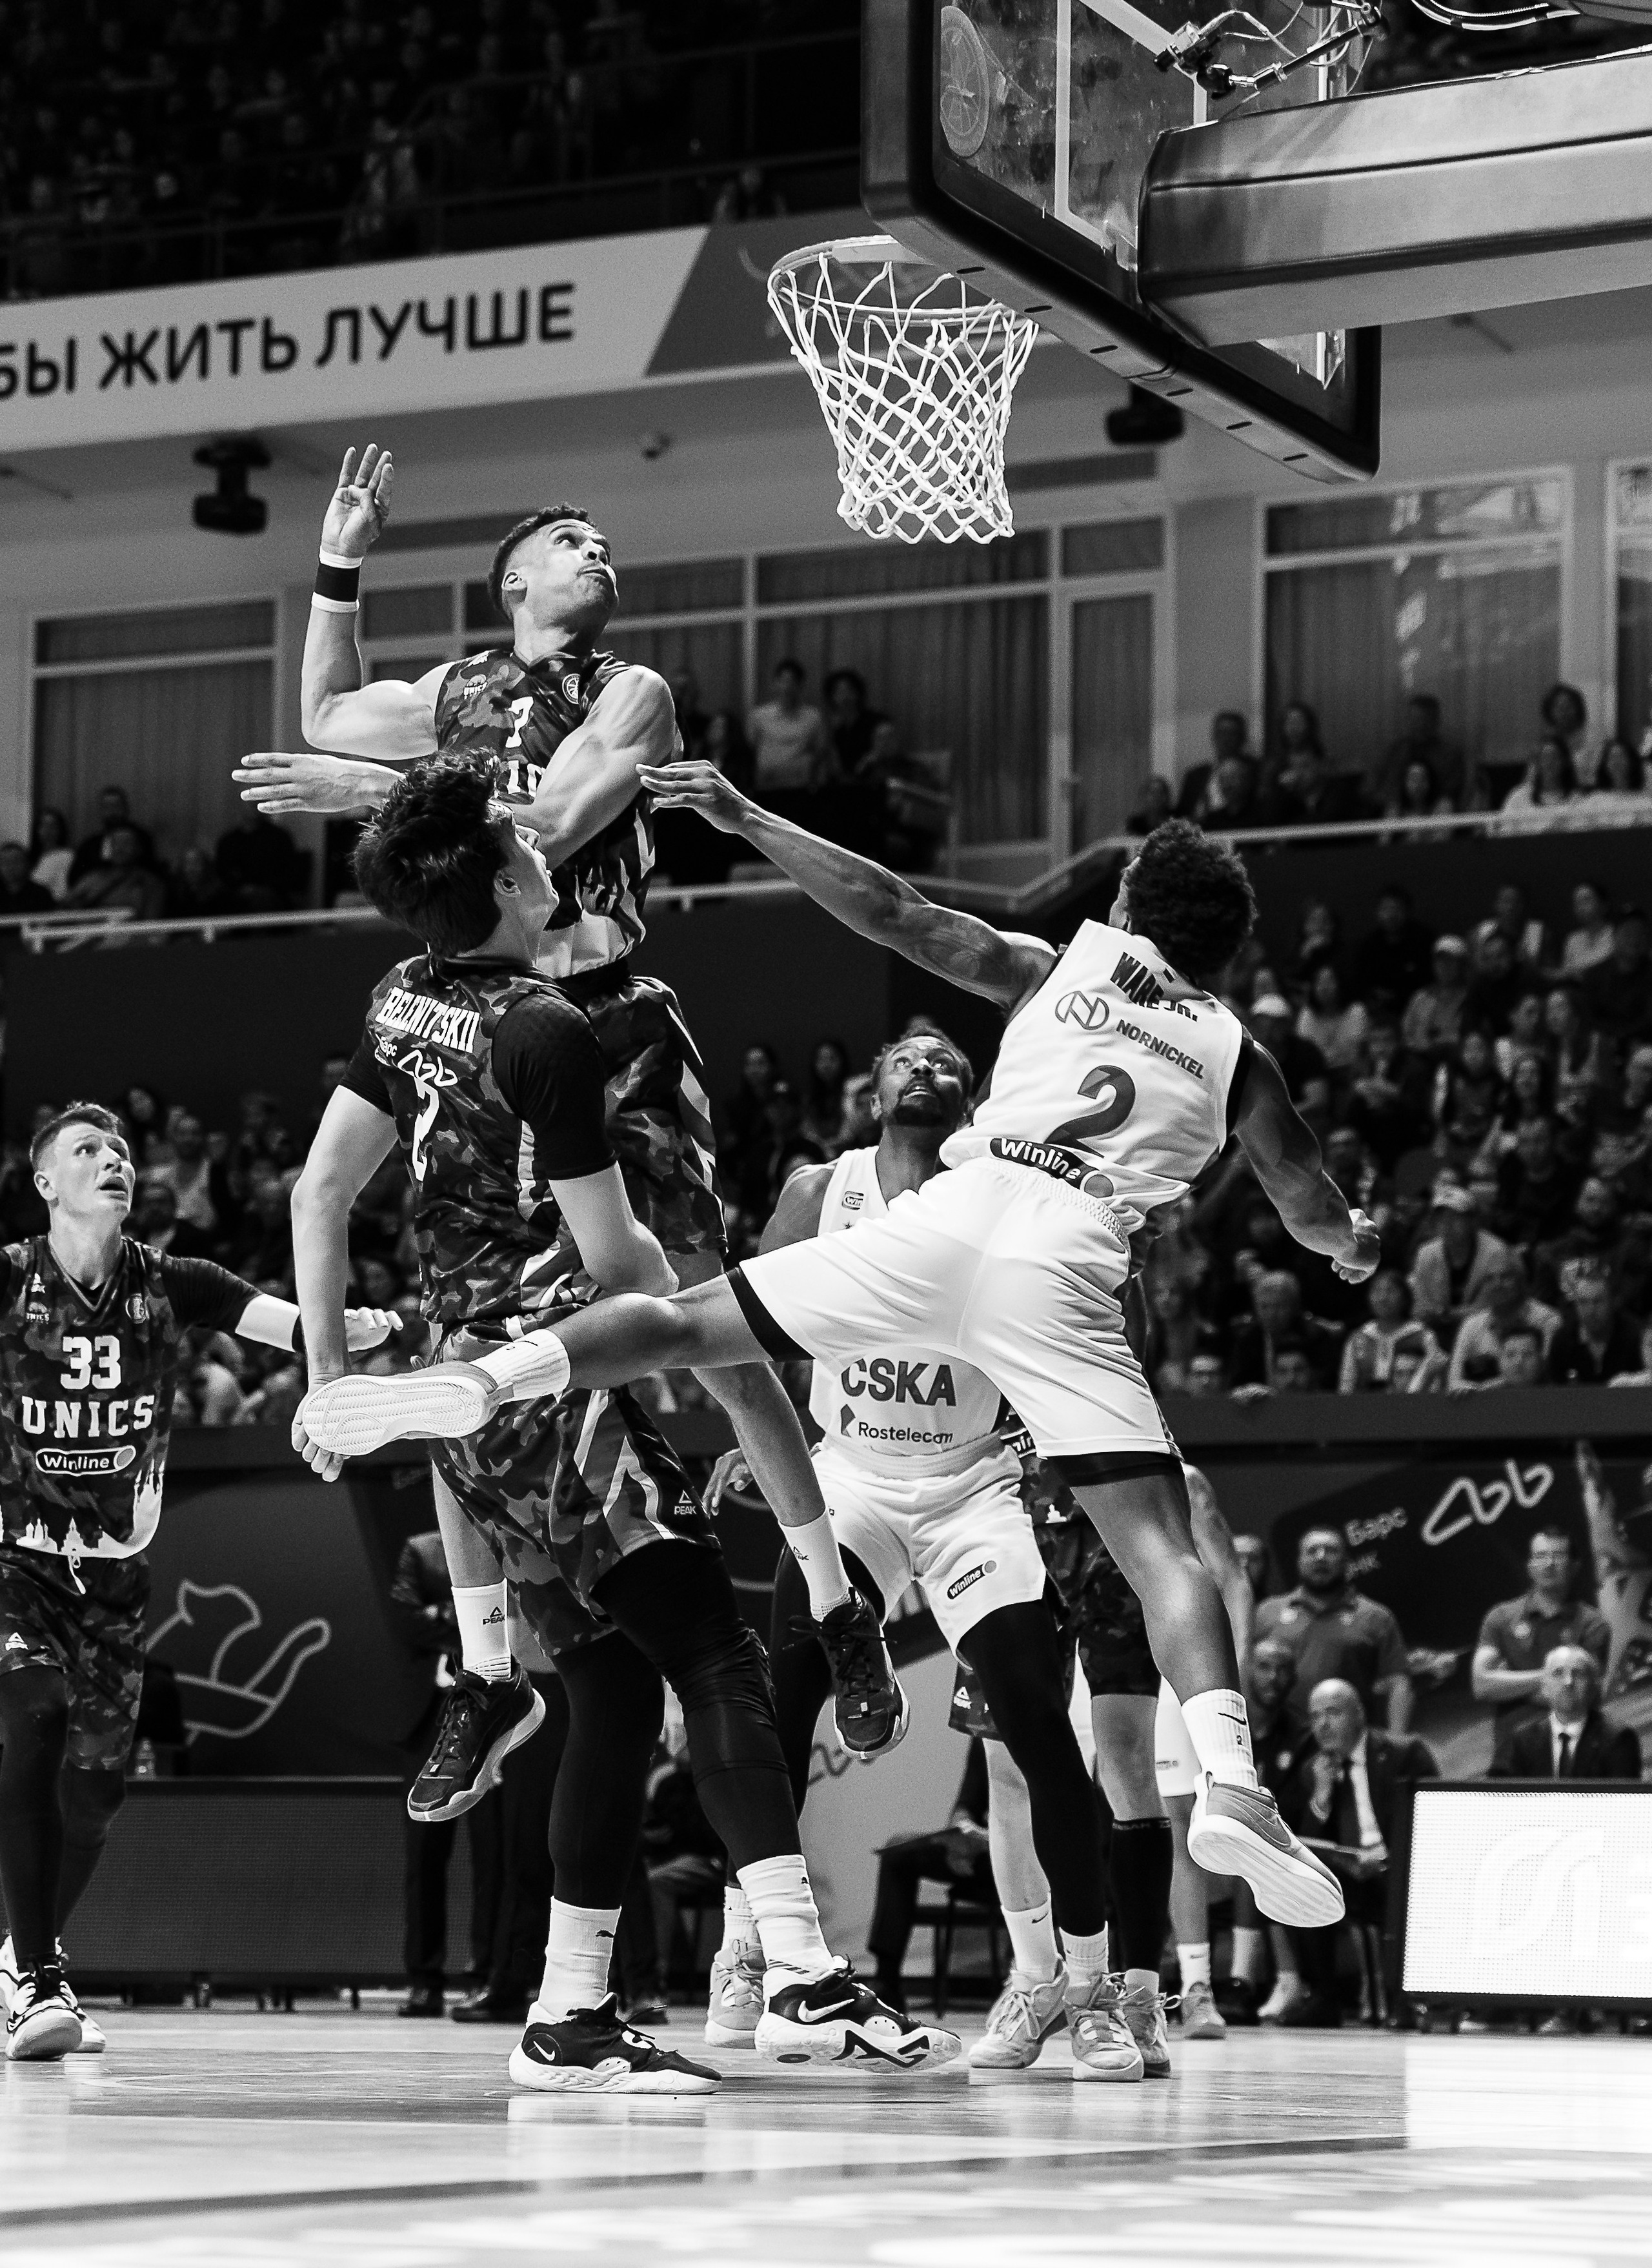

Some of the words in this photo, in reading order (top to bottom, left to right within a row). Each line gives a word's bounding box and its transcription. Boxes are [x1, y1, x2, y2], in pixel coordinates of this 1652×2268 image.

[99, 315, 299, 390] ЖИТЬ
[315, 282, 574, 367] ЛУЧШЕ
[375, 986, 480, 1053] BELENITSKII
[1116, 1019, 1204, 1080] NORNICKEL
[412, 1077, 439, 1182] 2
[1043, 1064, 1136, 1158] 2
[1000, 1138, 1082, 1180] Winline
[60, 1335, 121, 1390] 33
[841, 1357, 956, 1407] CSKA
[21, 1395, 155, 1439] UNICS
[43, 1453, 110, 1471] Winline
[674, 1505, 697, 1515] PEAK
[949, 1570, 982, 1597] Winline
